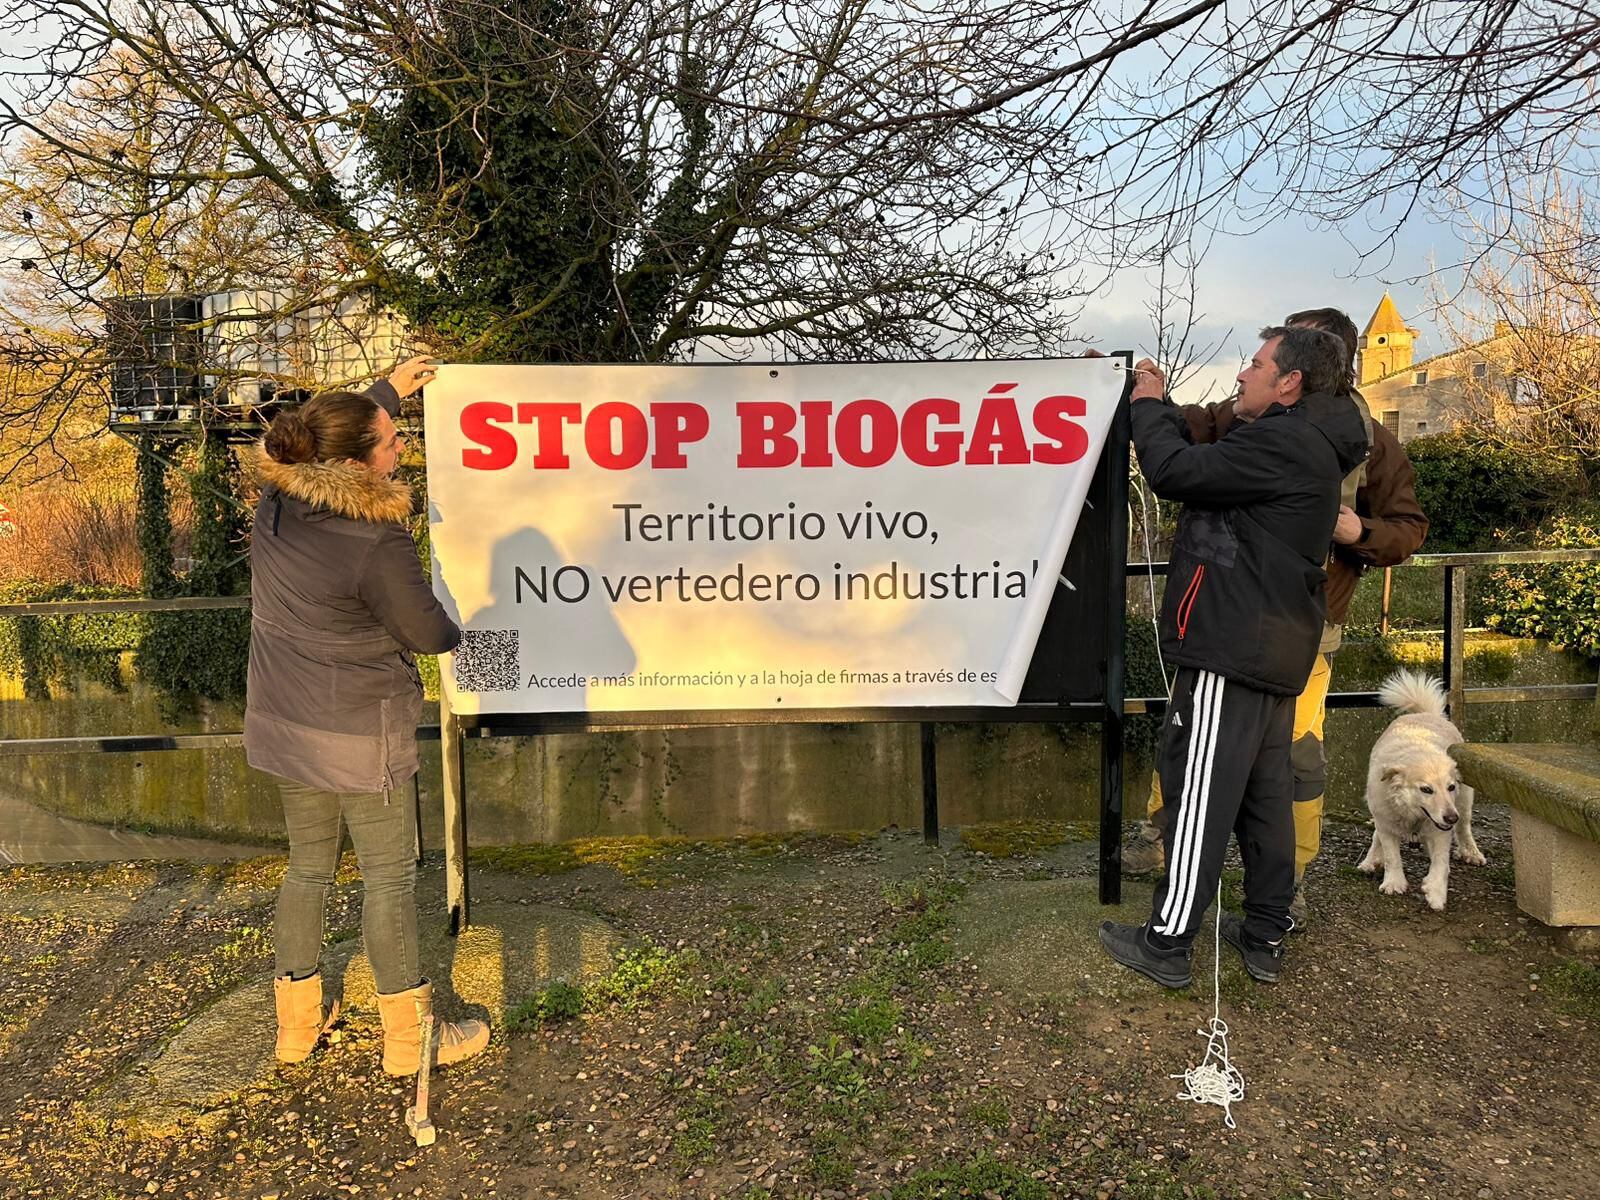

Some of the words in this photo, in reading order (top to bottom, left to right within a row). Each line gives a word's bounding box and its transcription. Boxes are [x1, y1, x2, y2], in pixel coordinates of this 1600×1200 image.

[459, 401, 709, 471] STOP
[736, 384, 1088, 468] BIOGÁS
[612, 502, 825, 542] Territorio
[836, 501, 939, 545] vivo,
[514, 566, 590, 604] NO
[601, 563, 821, 602] vertedero
[527, 673, 586, 688] Accede
[590, 677, 599, 687] a
[603, 672, 635, 687] más
[638, 671, 733, 687] información
[738, 674, 747, 688] y
[749, 675, 758, 685] a
[763, 670, 776, 685] la
[780, 670, 813, 688] hoja
[817, 670, 836, 685] de
[840, 669, 889, 684] firmas
[893, 673, 901, 684] a
[905, 668, 953, 683] través
[957, 668, 977, 683] de
